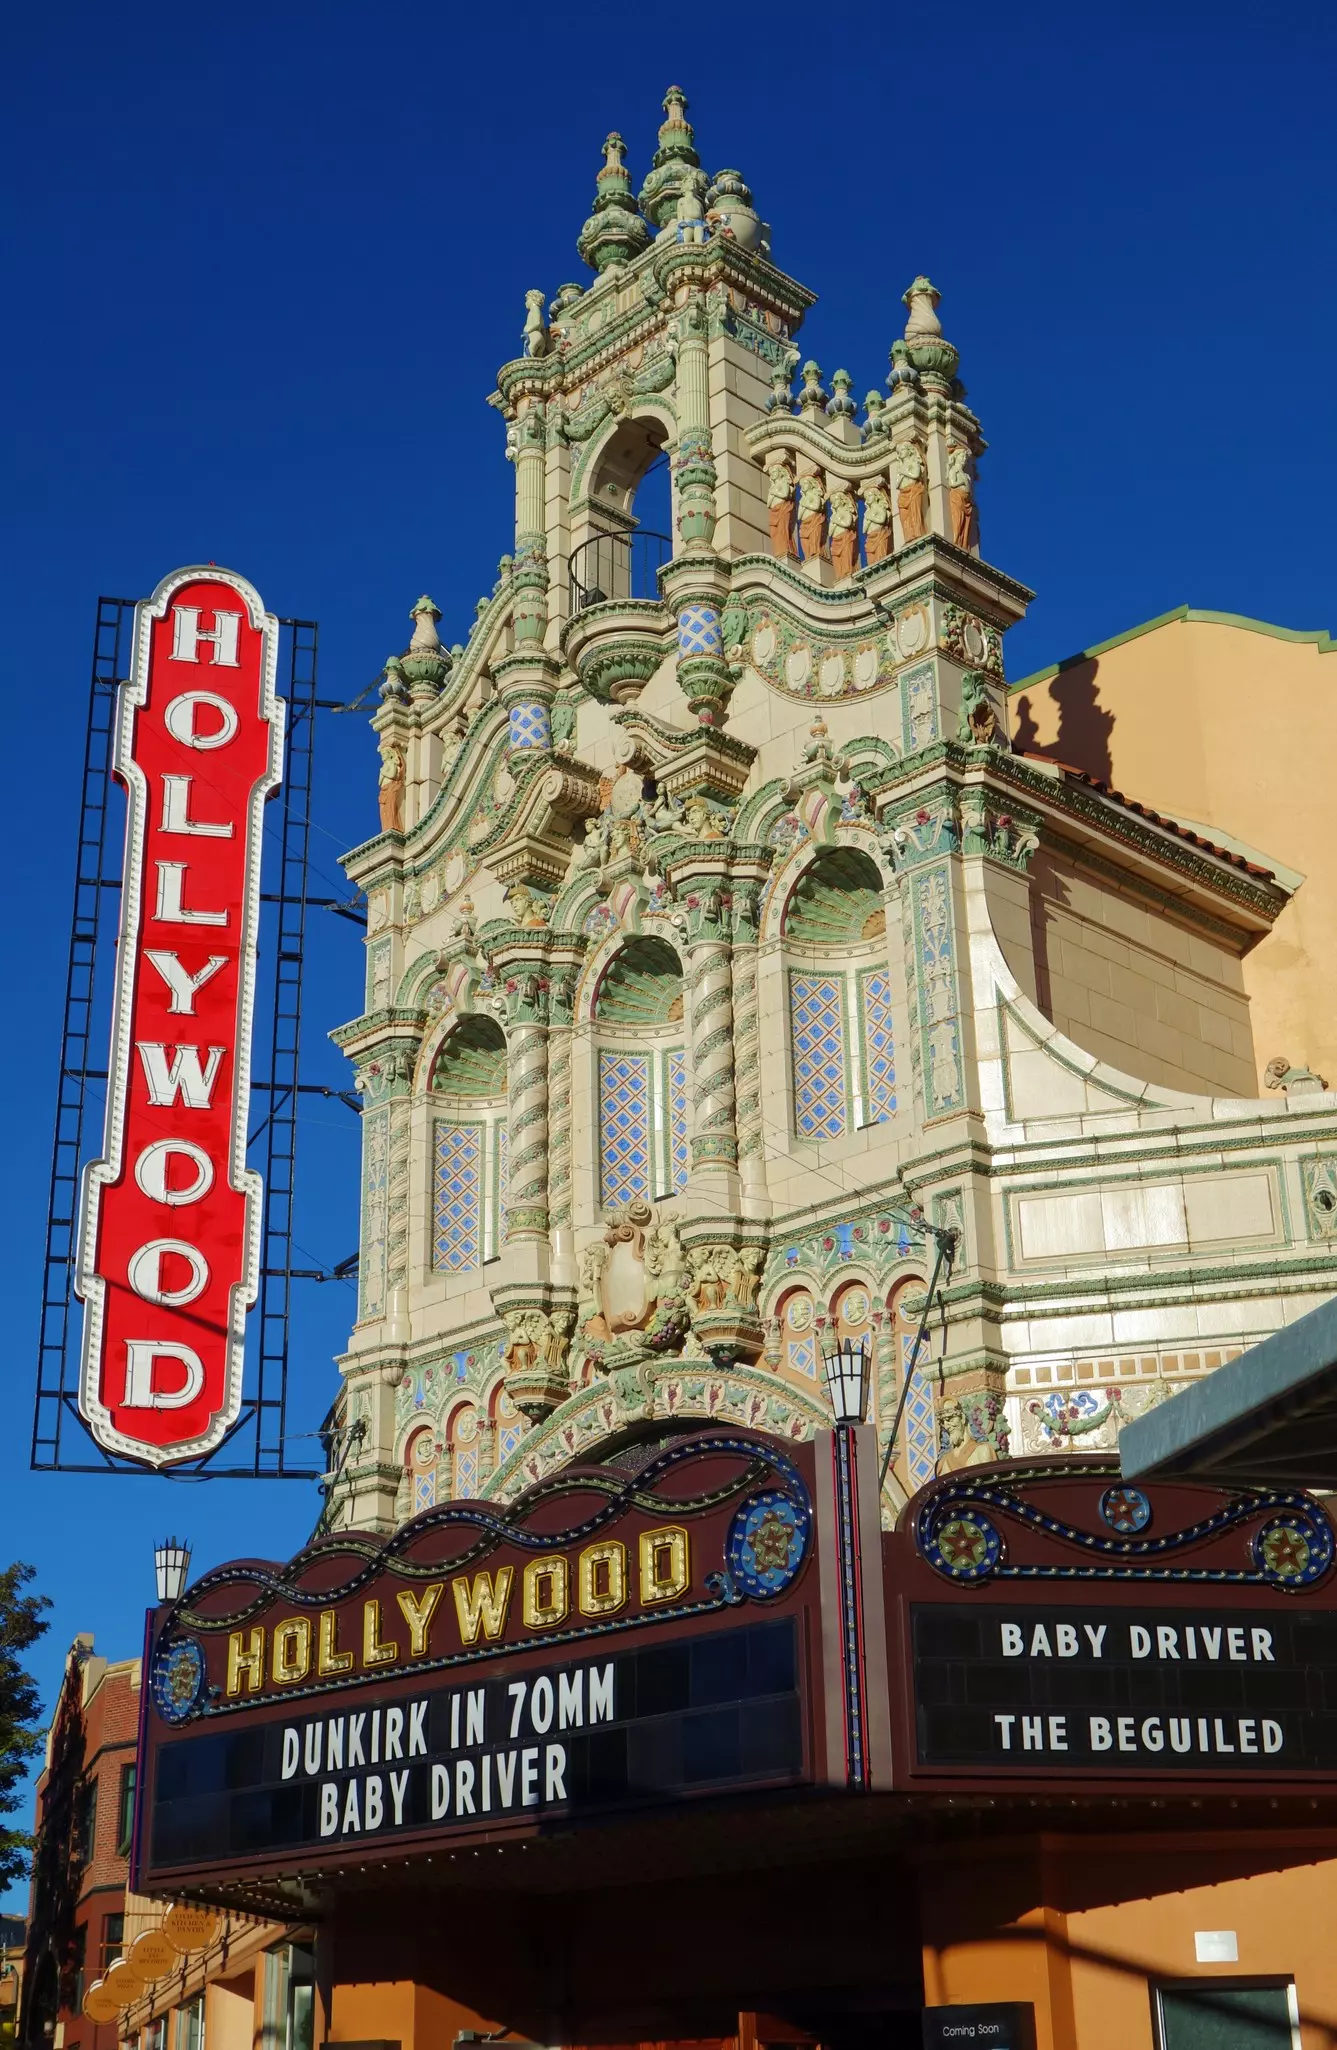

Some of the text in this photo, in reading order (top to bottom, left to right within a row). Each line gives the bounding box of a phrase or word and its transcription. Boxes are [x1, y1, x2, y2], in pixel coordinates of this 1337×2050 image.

[118, 605, 244, 1410] HOLLYWOOD
[226, 1525, 691, 1697] HOLLYWOOD
[1000, 1623, 1276, 1661] BABY DRIVER
[280, 1662, 616, 1780] DUNKIRK IN 70MM
[994, 1714, 1284, 1754] THE BEGUILED
[319, 1743, 568, 1837] BABY DRIVER
[942, 2023, 1000, 2037] Coming Soon
